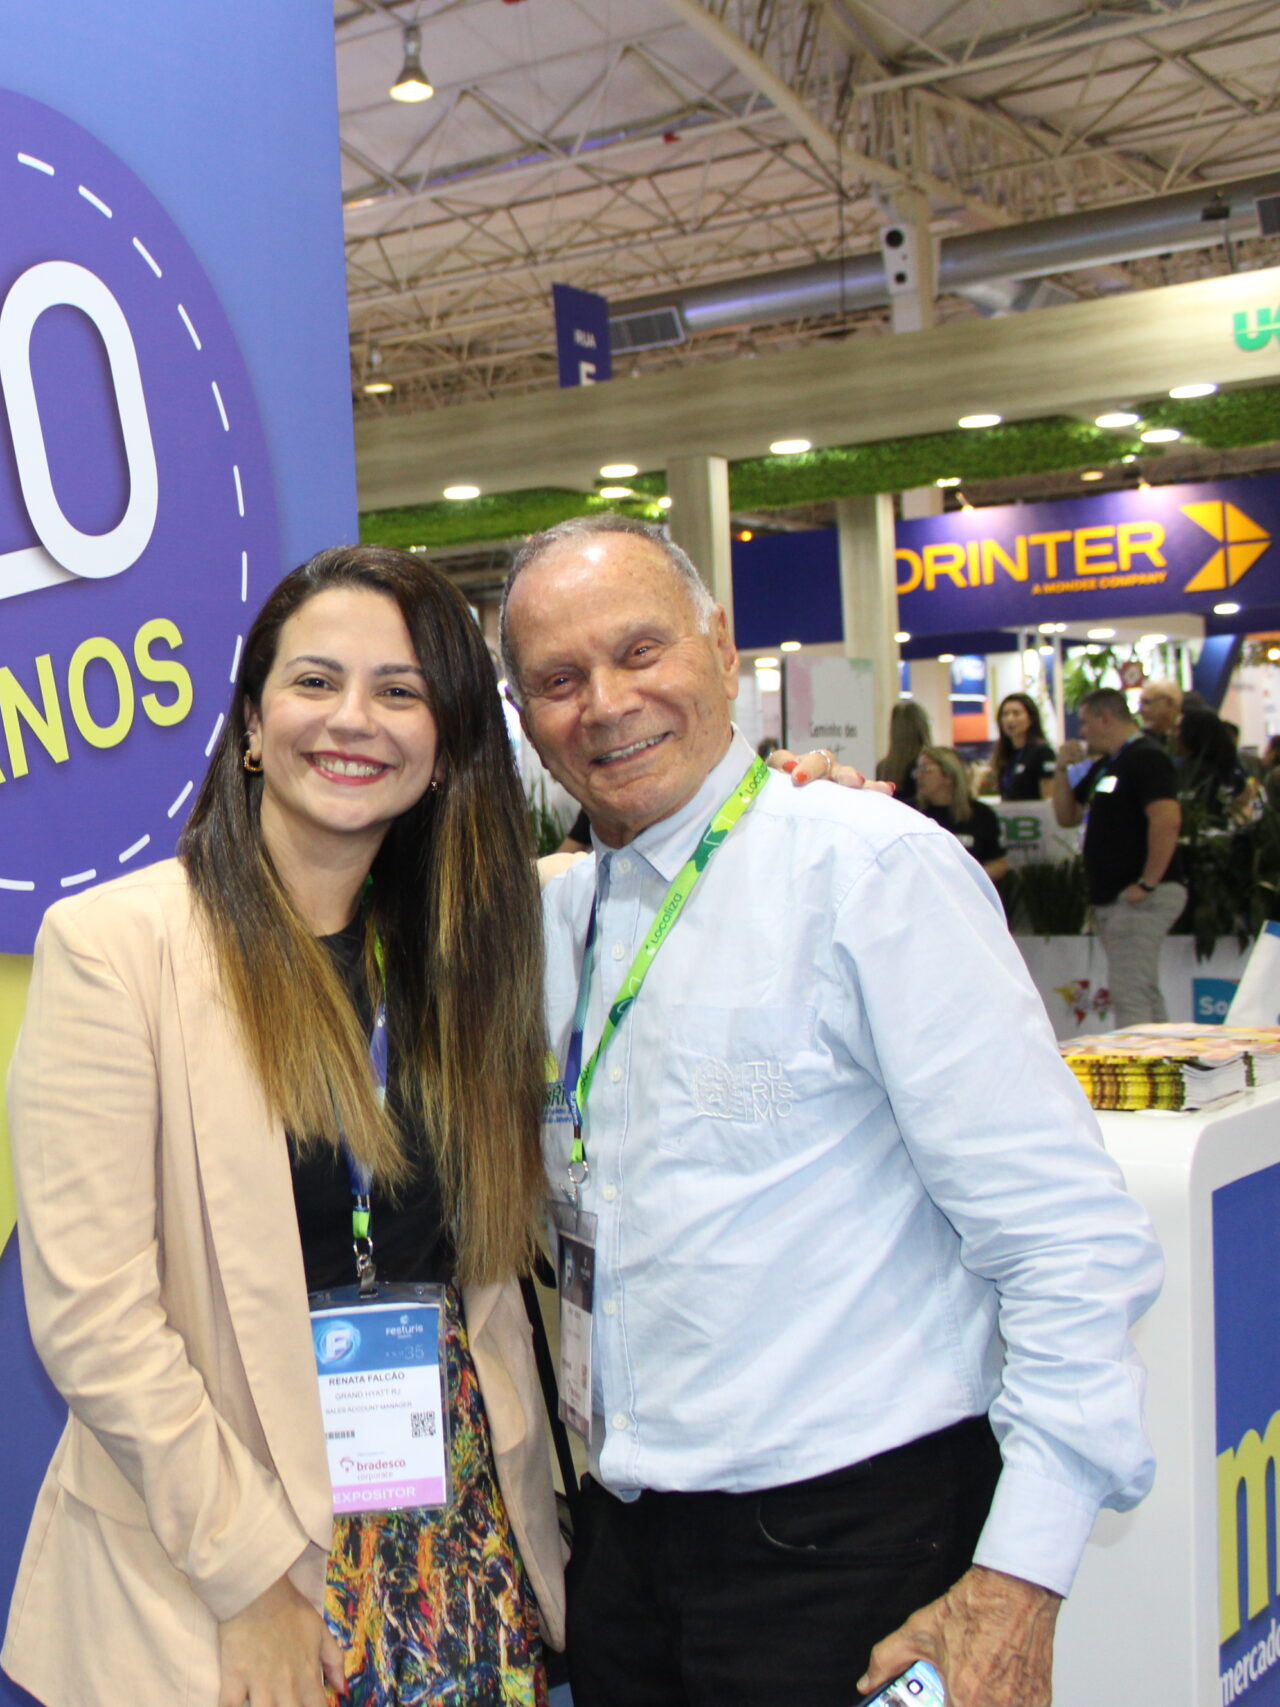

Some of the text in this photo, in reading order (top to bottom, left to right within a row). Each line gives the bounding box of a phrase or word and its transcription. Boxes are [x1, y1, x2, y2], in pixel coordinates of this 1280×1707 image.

[1099, 571, 1168, 590] COMPANY
[328, 1375, 366, 1386] RENATA
[335, 1390, 363, 1401] GRAND
[365, 1387, 389, 1397] HYATT
[380, 1400, 412, 1410] MANAGER
[356, 1458, 406, 1472] bradesco
[333, 1486, 417, 1504] EXPOSITOR
